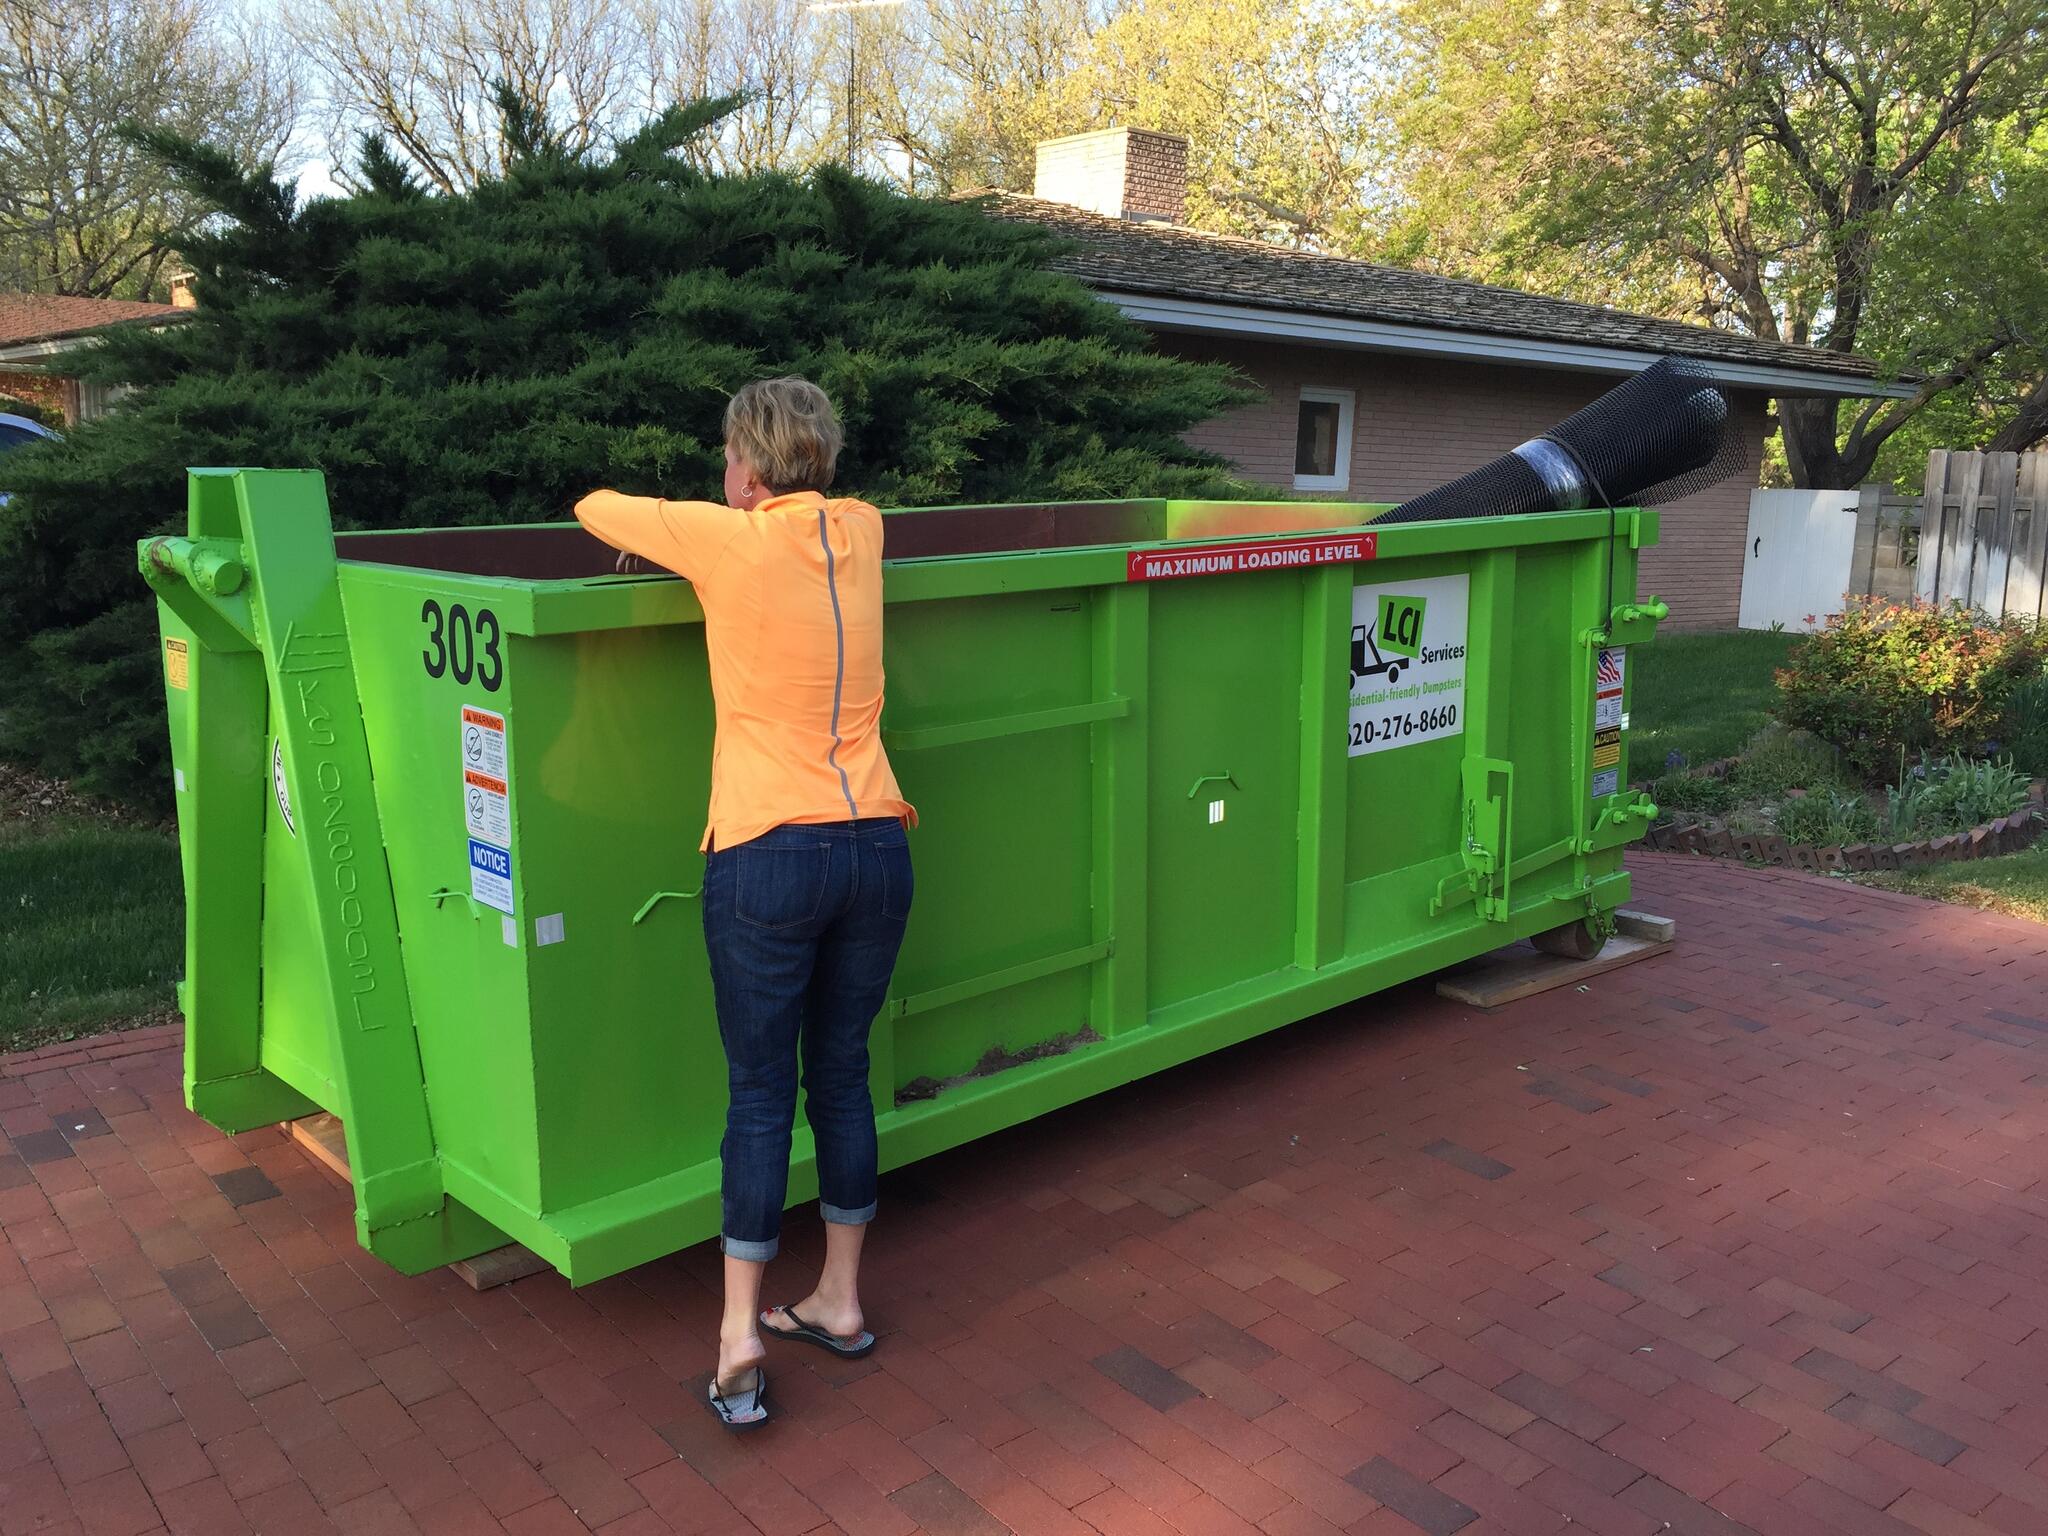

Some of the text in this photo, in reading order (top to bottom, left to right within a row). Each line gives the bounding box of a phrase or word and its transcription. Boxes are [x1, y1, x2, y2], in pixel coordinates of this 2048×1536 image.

[1146, 544, 1362, 577] MAXIMUM LOADING LEVEL
[1383, 601, 1421, 648] LCI
[421, 599, 503, 692] 303
[1421, 643, 1465, 665] Services
[1422, 677, 1462, 695] Dumpsters
[473, 845, 507, 874] NOTICE
